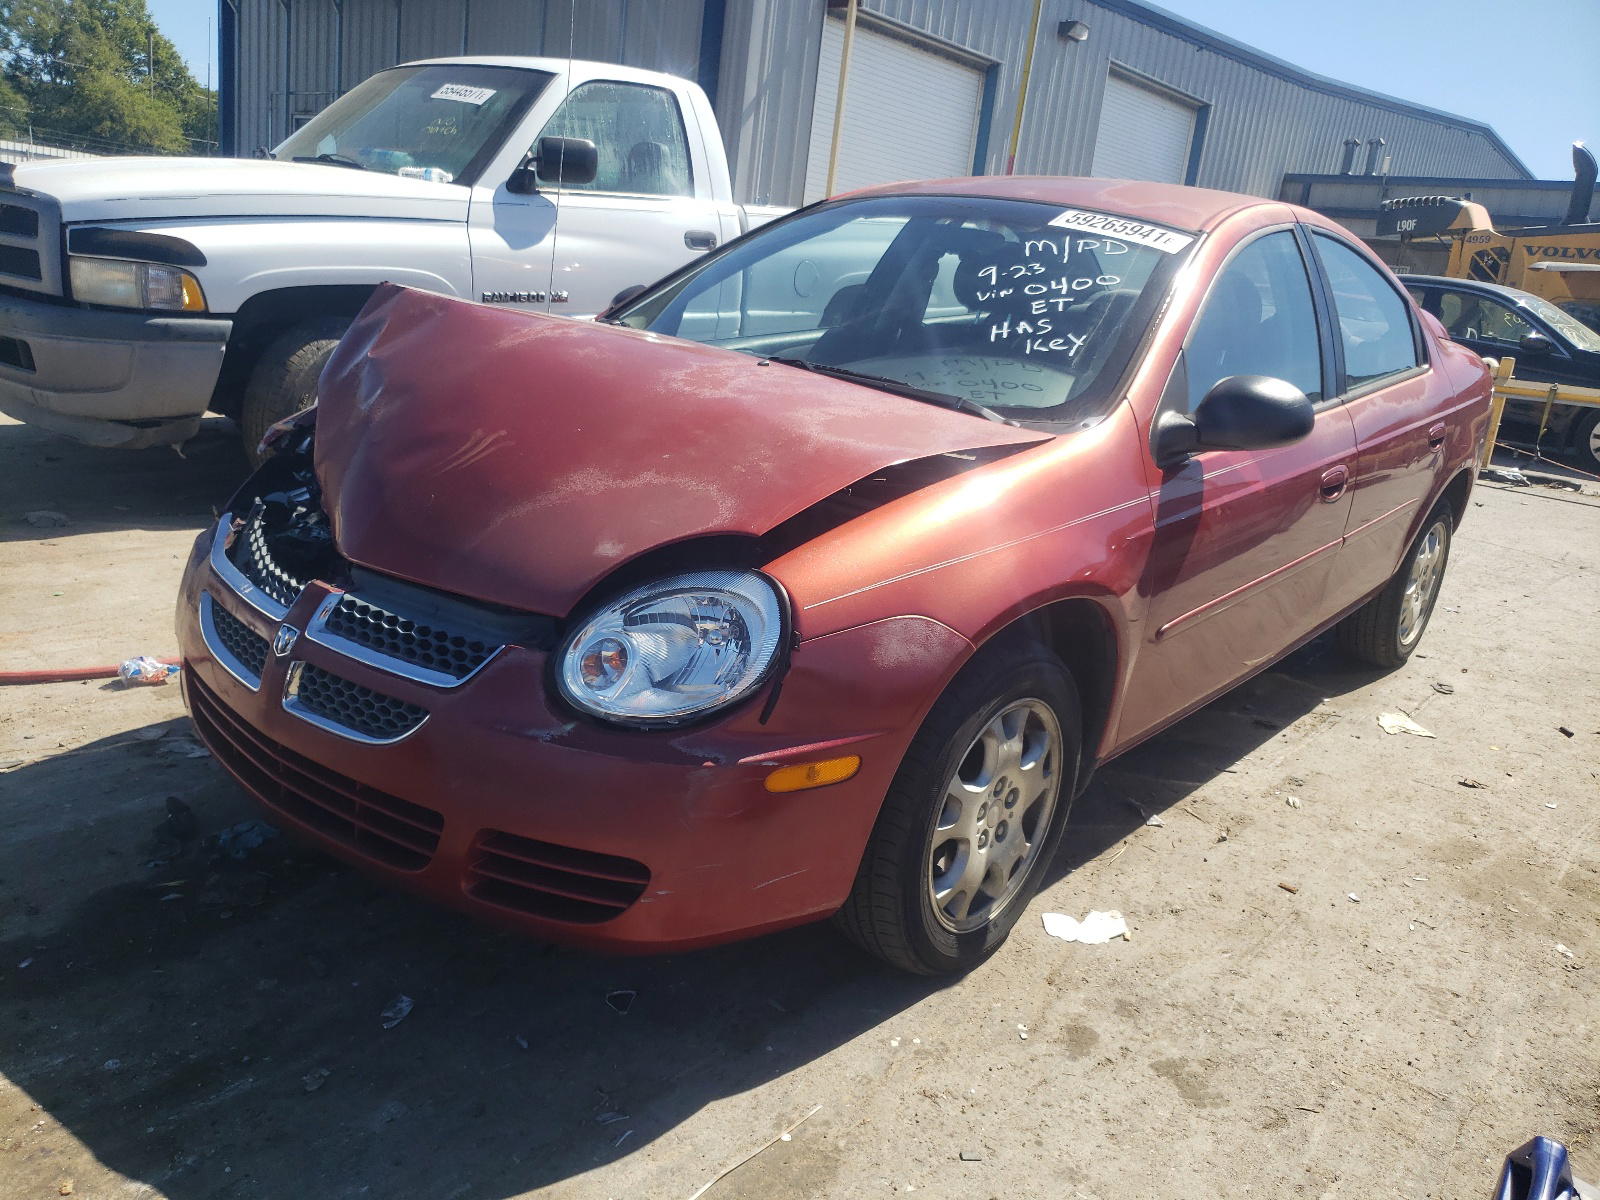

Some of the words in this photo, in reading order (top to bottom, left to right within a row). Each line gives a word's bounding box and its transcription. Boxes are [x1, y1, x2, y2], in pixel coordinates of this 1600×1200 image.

[1397, 219, 1417, 232] L90F
[978, 263, 1046, 285] 9-23
[1024, 276, 1120, 295] 0400
[1031, 298, 1074, 314] ET
[990, 318, 1052, 342] HAS
